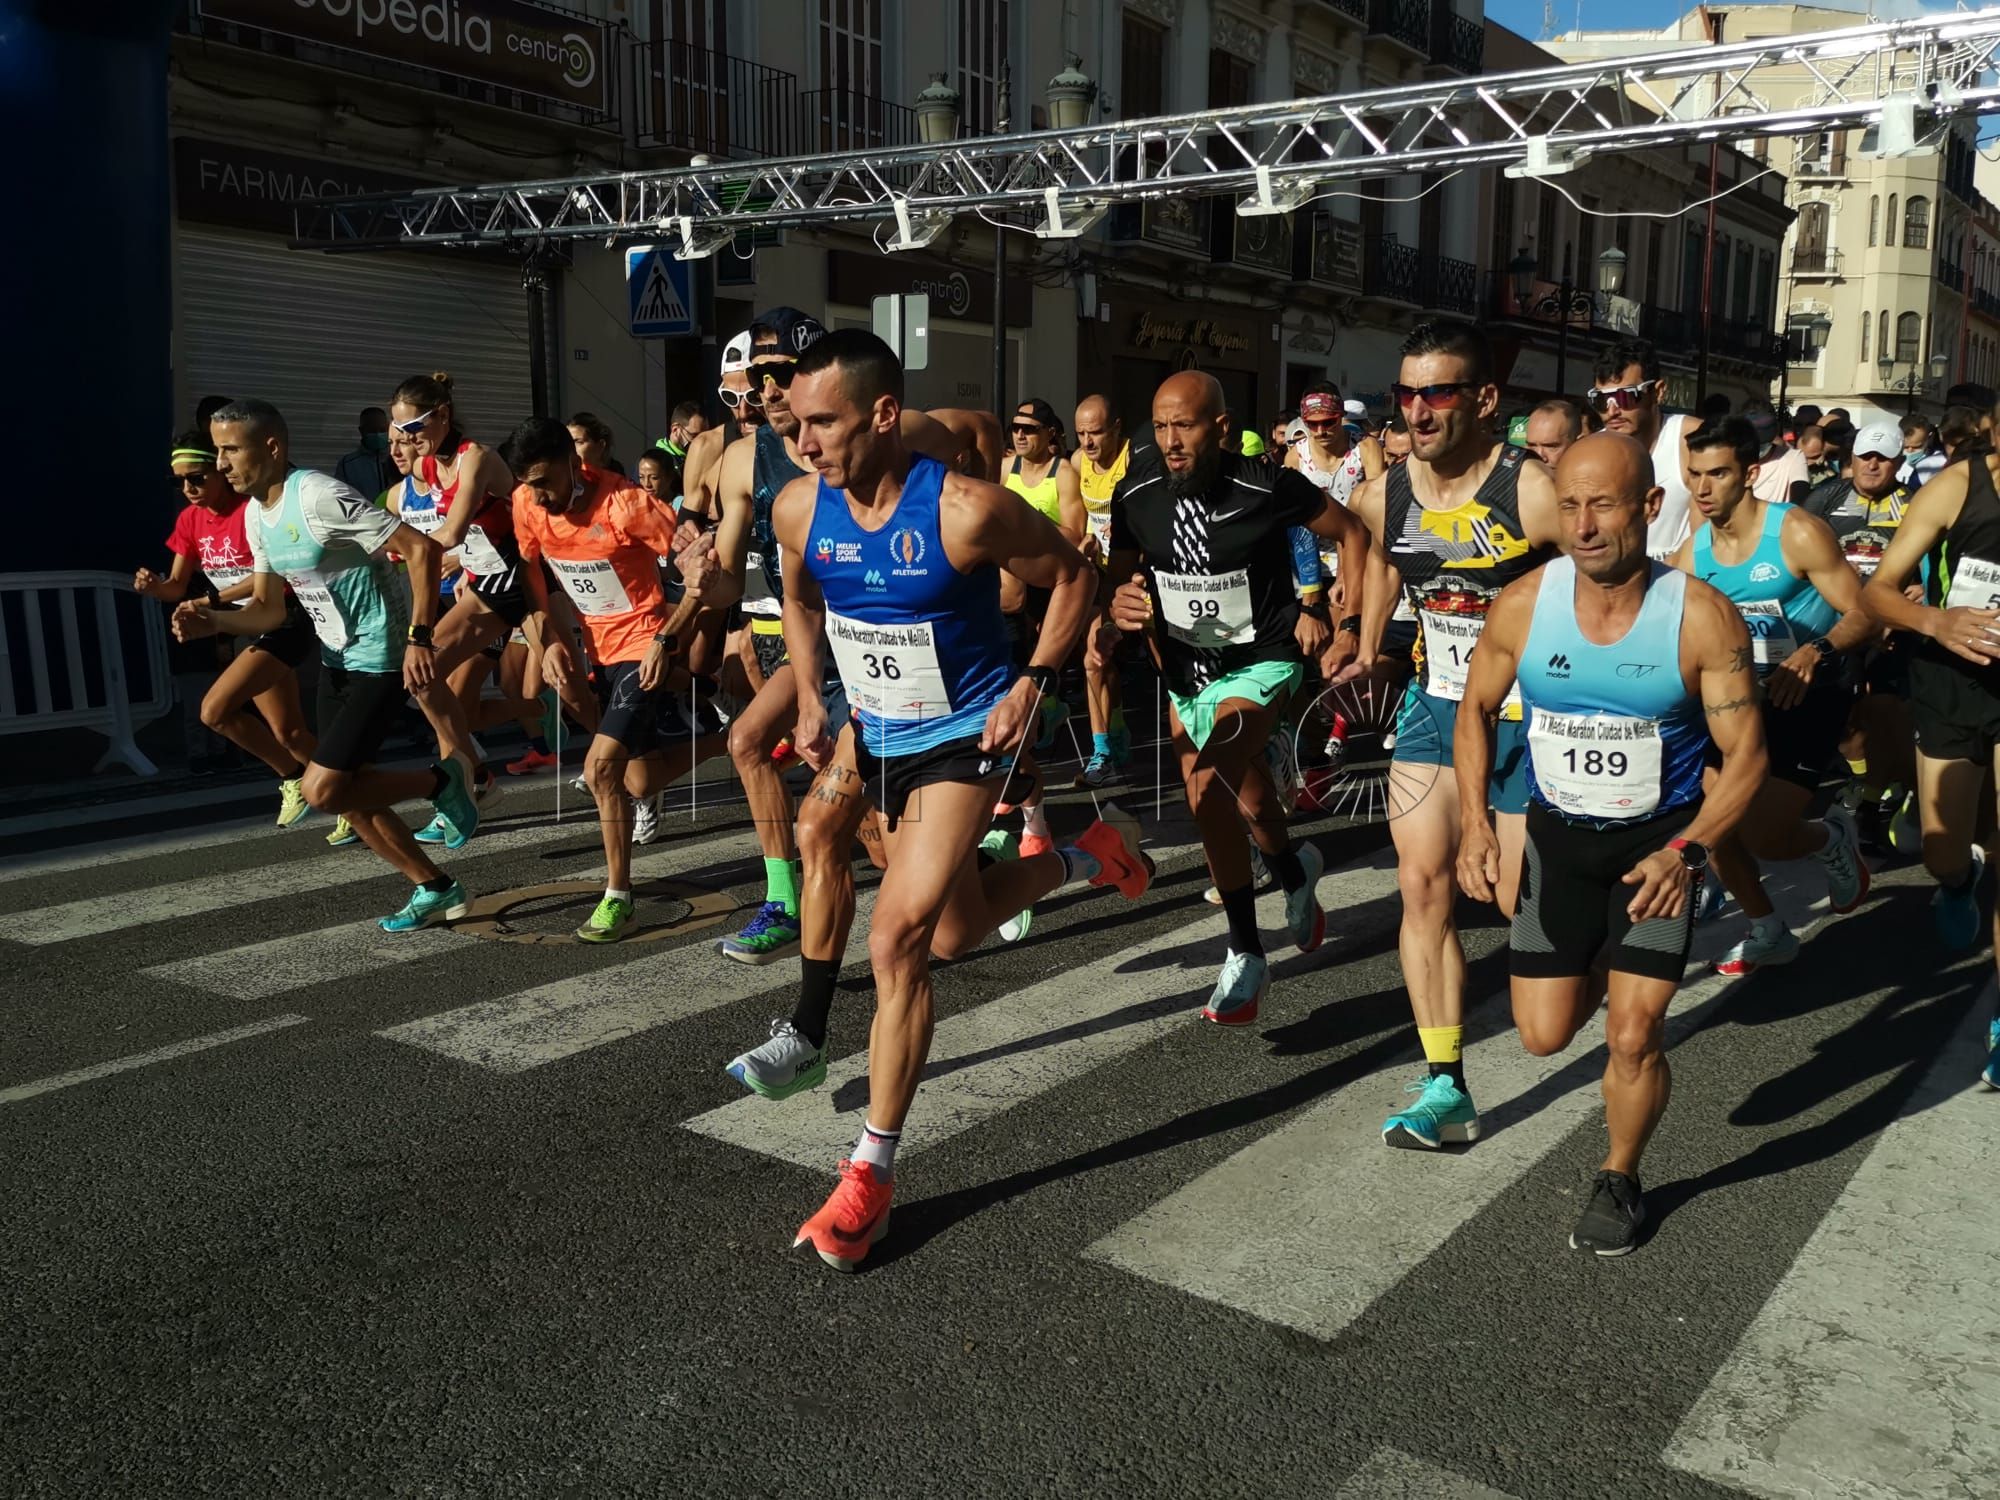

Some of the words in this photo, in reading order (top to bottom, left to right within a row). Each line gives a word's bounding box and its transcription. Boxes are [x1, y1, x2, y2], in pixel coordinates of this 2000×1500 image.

[506, 33, 583, 71] centro
[835, 542, 862, 550] MELILLA
[835, 555, 863, 563] CAPITAL
[891, 568, 928, 577] ATLETISMO
[571, 578, 598, 594] 58
[1188, 599, 1220, 619] 99
[907, 628, 931, 648] Melilla
[862, 652, 902, 681] 36
[1545, 670, 1570, 680] mobel
[1562, 748, 1629, 778] 189
